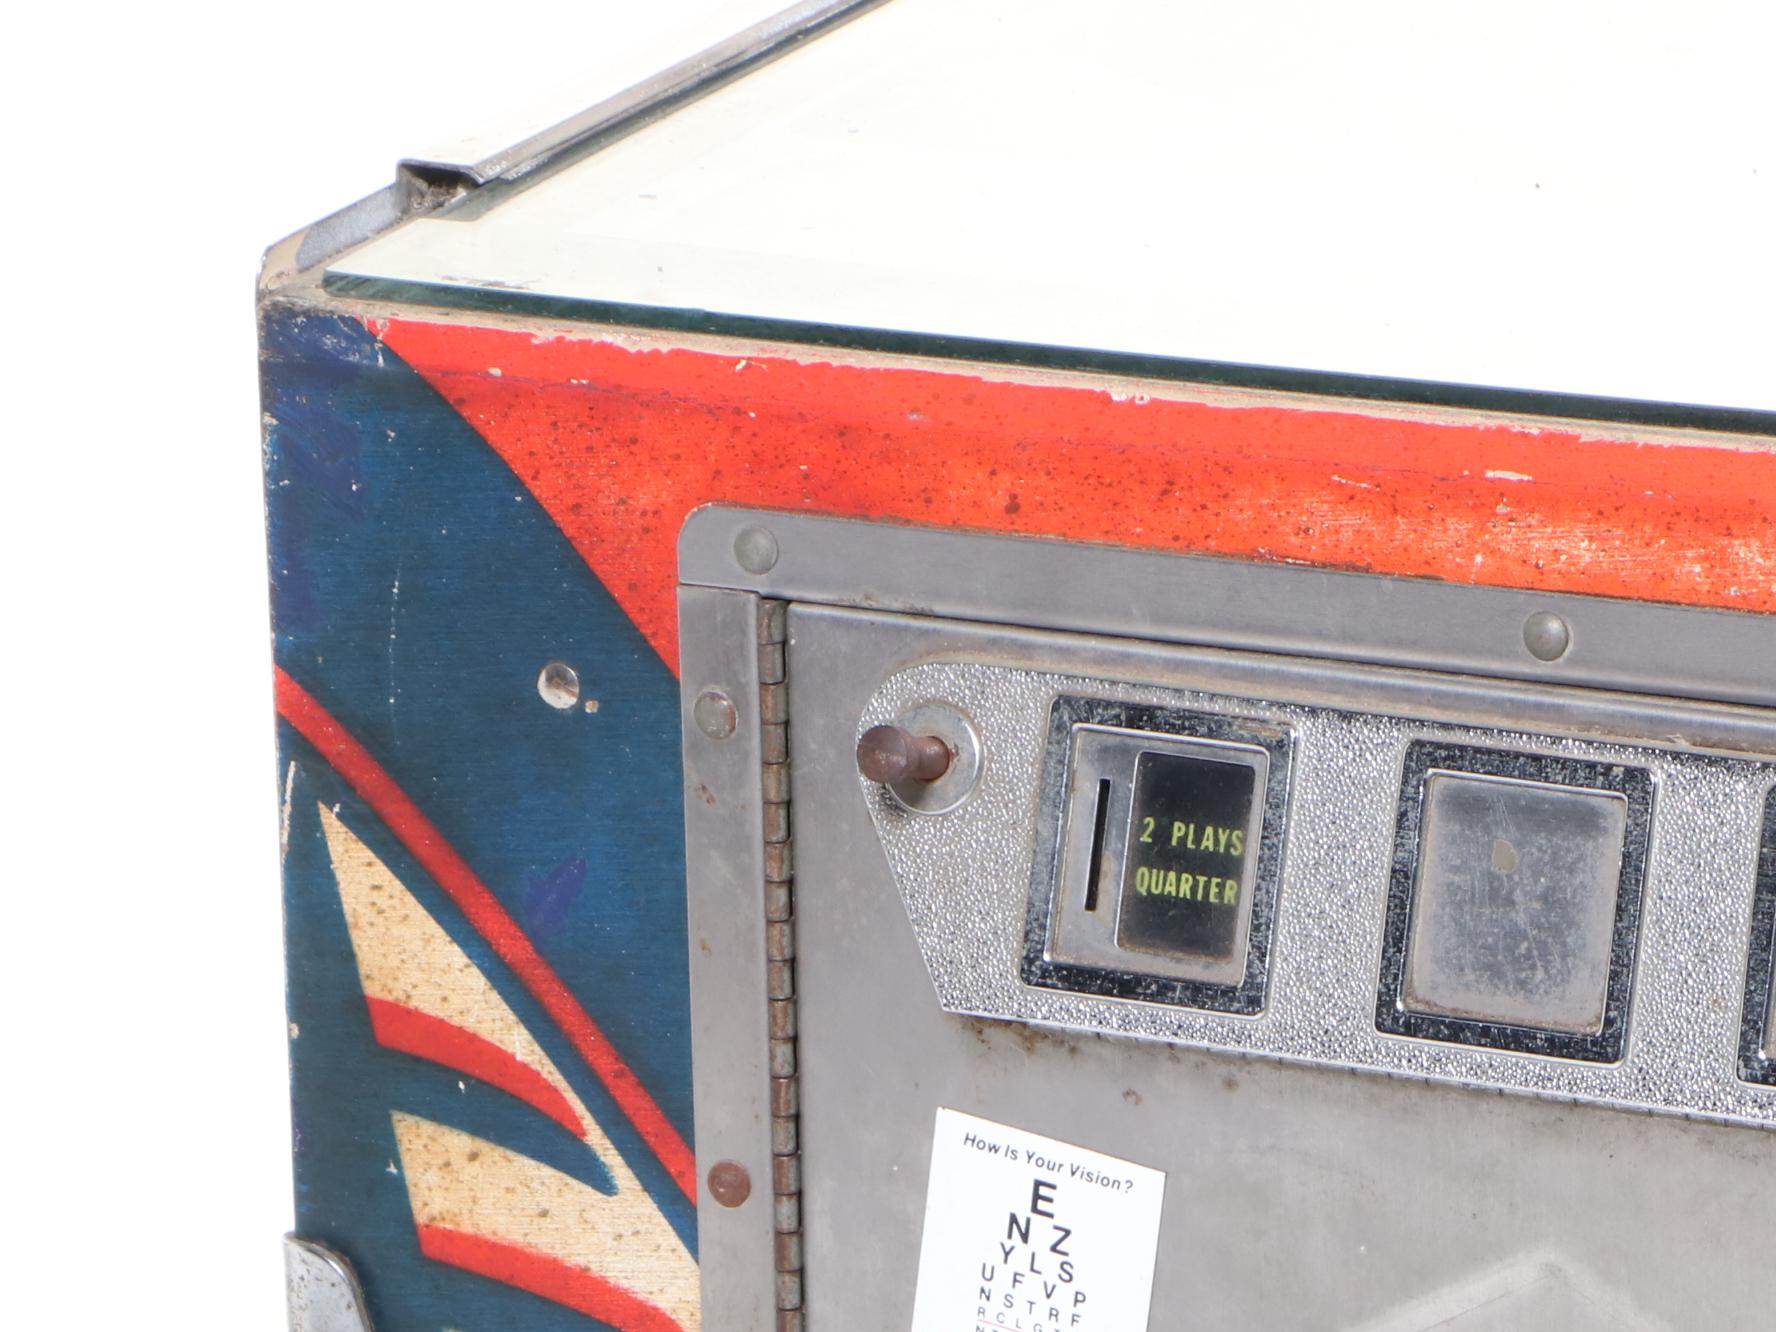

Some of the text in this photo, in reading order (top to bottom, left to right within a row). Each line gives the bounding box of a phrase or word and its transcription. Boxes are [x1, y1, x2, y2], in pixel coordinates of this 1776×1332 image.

[1139, 816, 1243, 856] 2 PLAYS
[1135, 866, 1238, 905] QUARTER
[963, 1132, 1001, 1155] How
[1004, 1145, 1019, 1161] Is
[1026, 1150, 1065, 1174] Your
[1030, 1178, 1058, 1220] E
